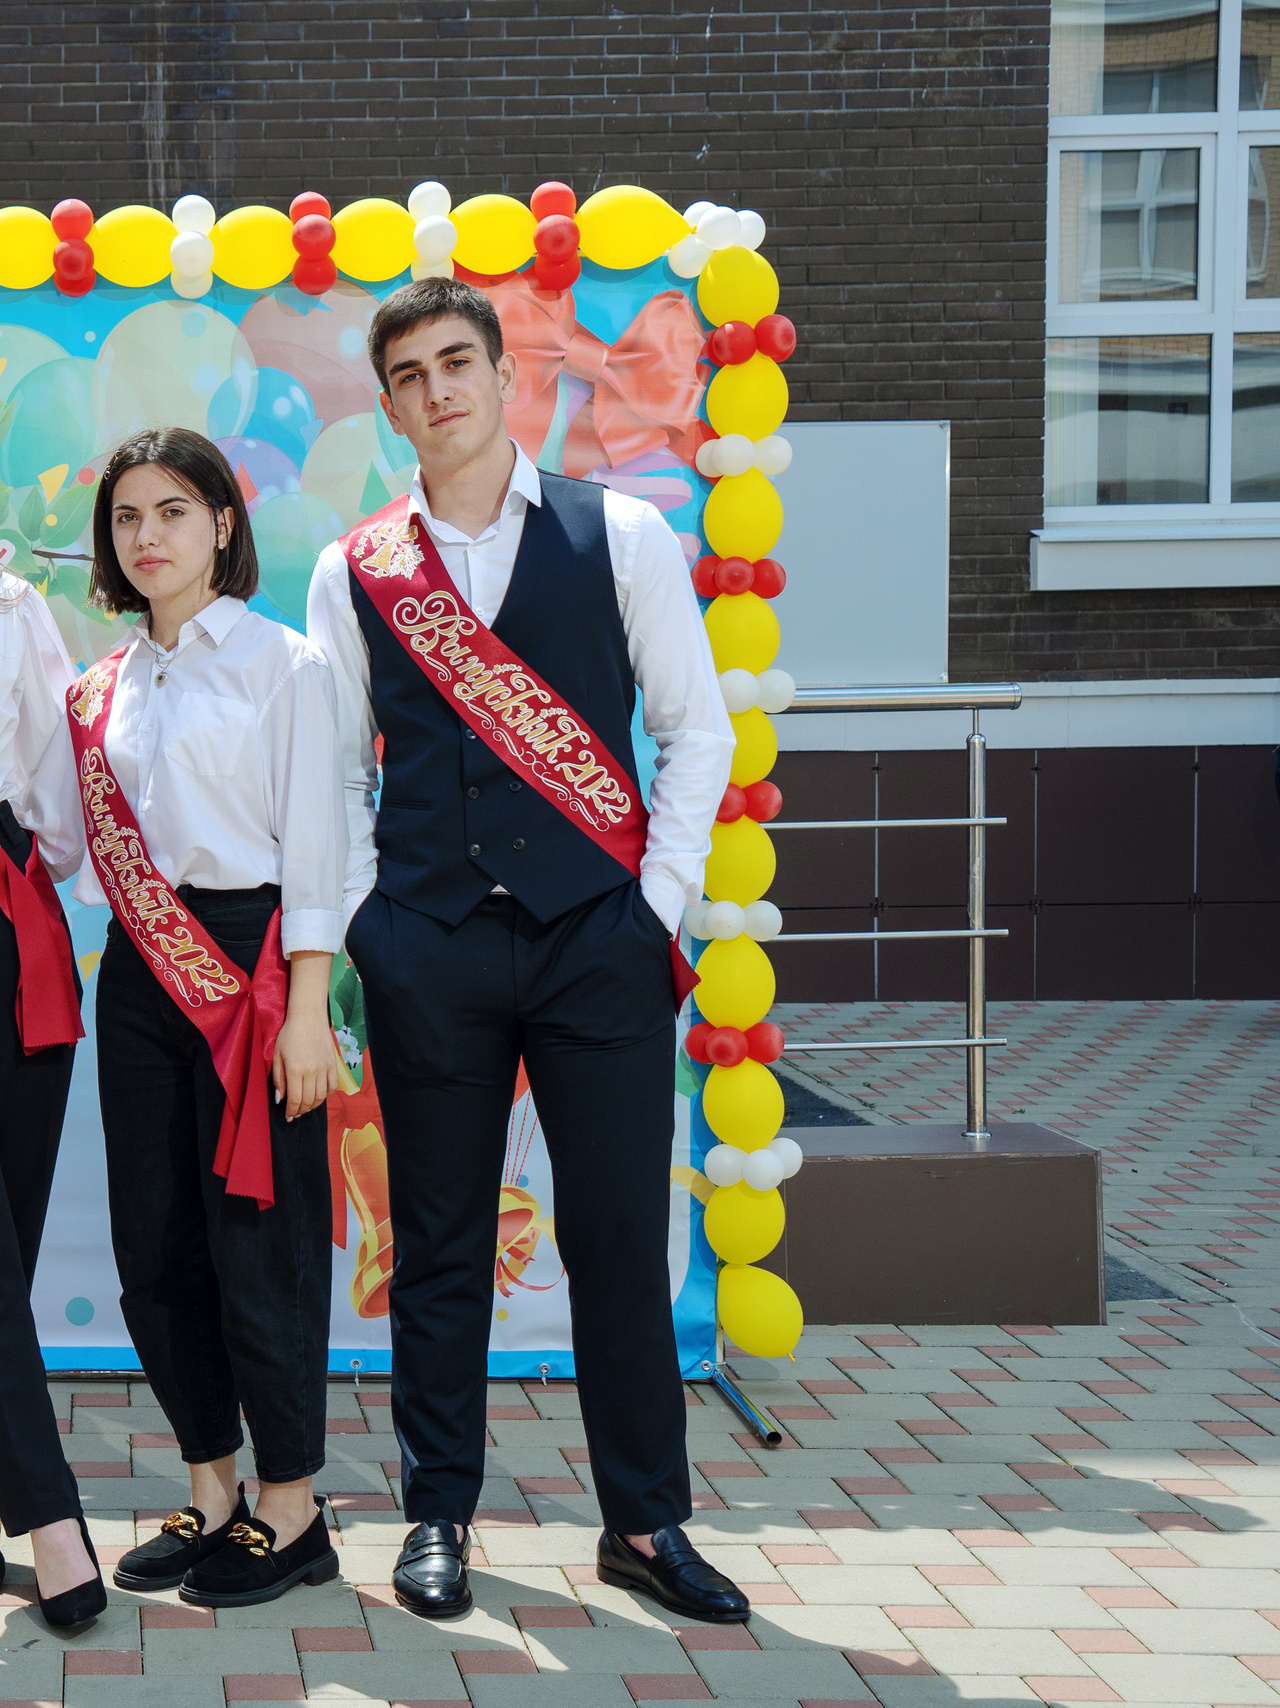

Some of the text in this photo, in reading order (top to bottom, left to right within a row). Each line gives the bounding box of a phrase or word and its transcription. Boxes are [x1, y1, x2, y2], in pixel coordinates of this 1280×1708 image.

[394, 591, 631, 823] Выпускник 2022
[81, 746, 240, 1002] Выпускник 2022
